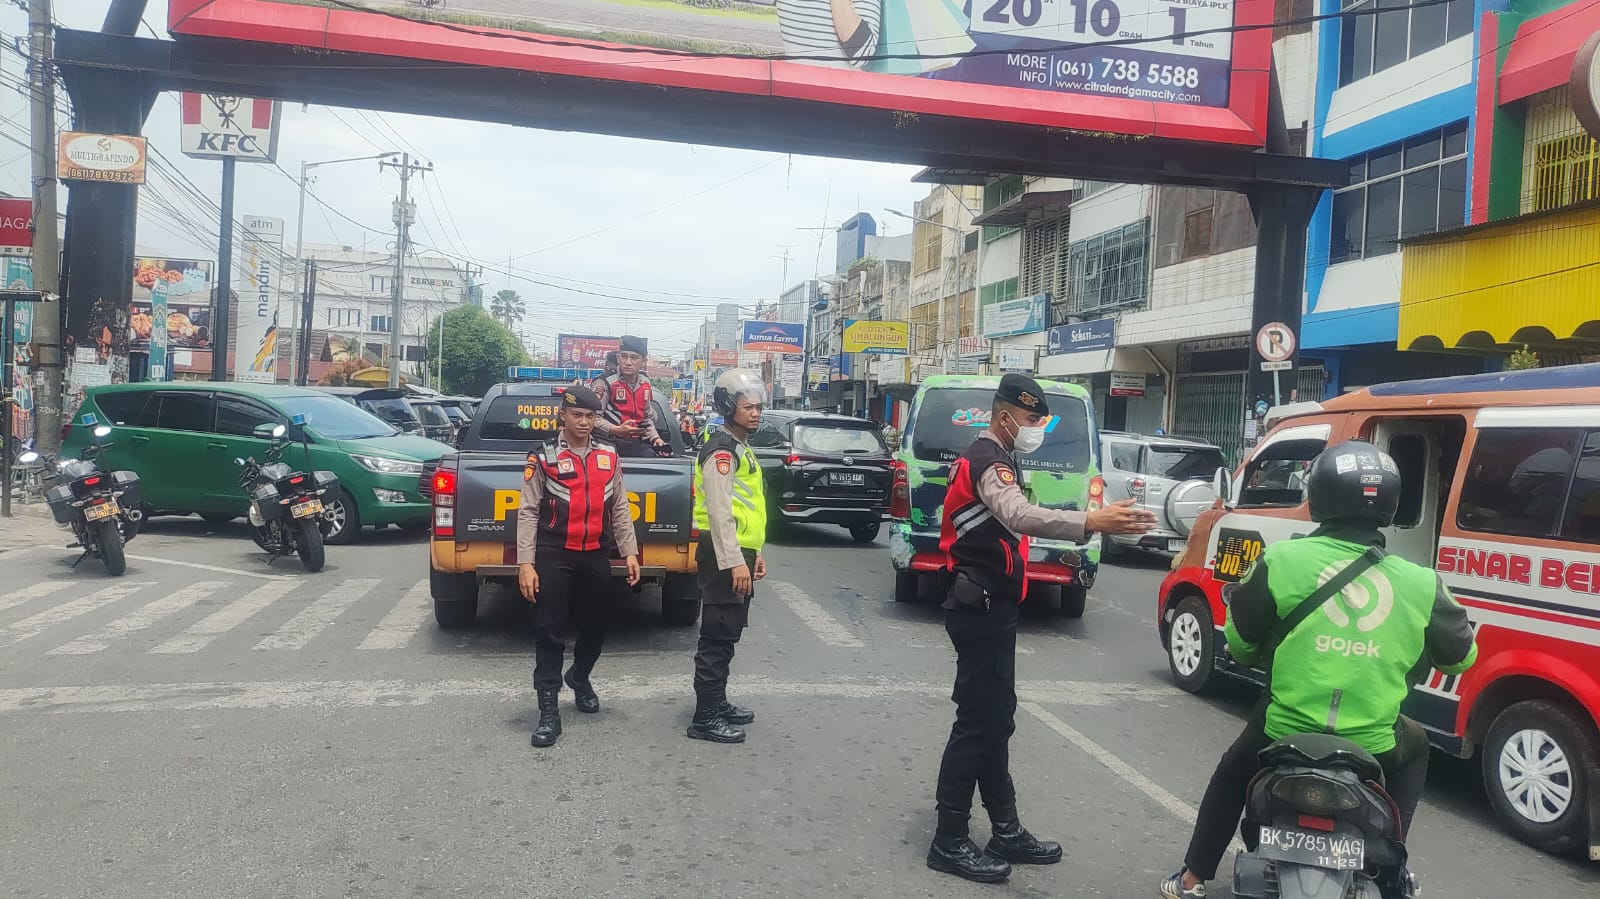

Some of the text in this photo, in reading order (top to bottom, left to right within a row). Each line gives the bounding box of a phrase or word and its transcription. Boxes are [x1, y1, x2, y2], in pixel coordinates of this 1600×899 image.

[983, 0, 1042, 26] 20
[1070, 0, 1143, 39] 10 GRAM
[1169, 6, 1214, 49] 1 Tahun
[1007, 53, 1047, 69] MORE
[1019, 70, 1047, 84] INFO
[1056, 57, 1200, 89] (061) 738 5588
[1056, 79, 1201, 103] www.citralandgamacity.com
[197, 132, 256, 153] KFC
[70, 151, 134, 163] MULTIGRAFINDO
[68, 167, 135, 180] (061)7867972
[251, 219, 273, 229] atm
[257, 260, 271, 318] mandiri
[749, 333, 799, 343] kimia farma
[851, 332, 903, 342] SIMALUNGUN
[518, 405, 551, 416] POLRES
[1315, 634, 1381, 658] gojek
[1261, 828, 1361, 855] BK 5785 WAG
